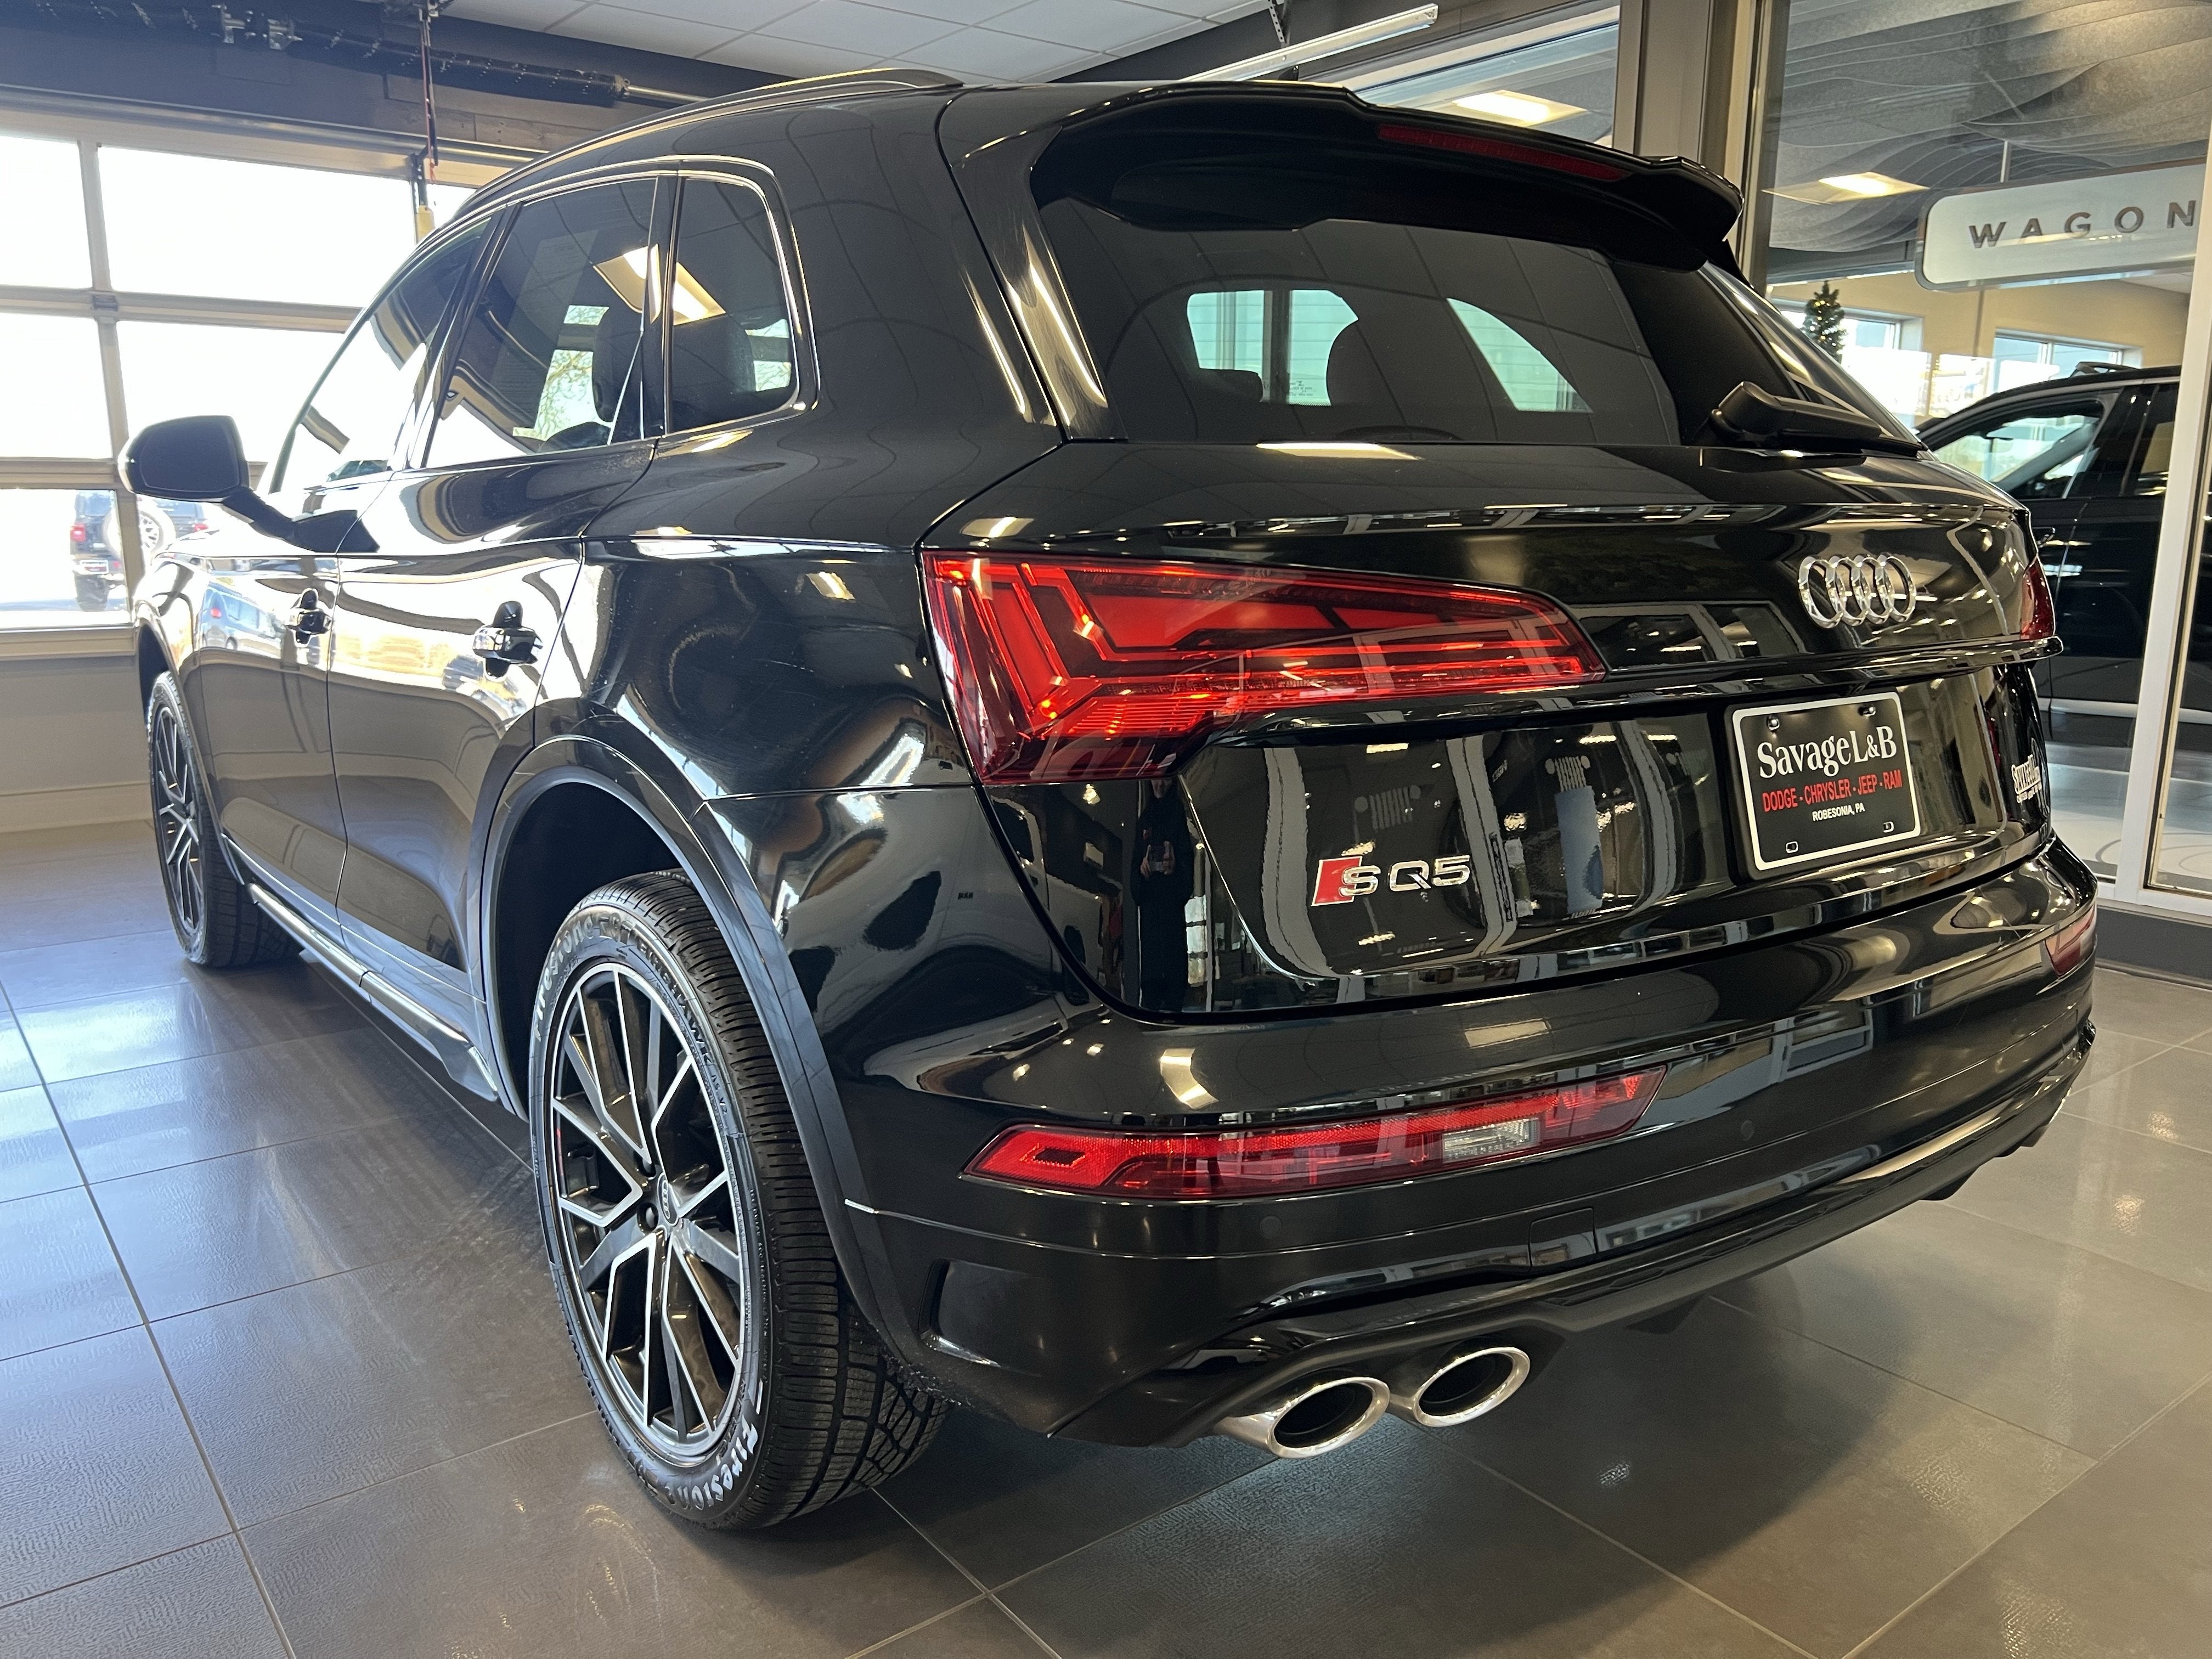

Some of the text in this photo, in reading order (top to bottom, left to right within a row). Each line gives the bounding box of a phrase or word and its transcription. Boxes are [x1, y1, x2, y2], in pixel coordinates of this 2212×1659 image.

[1968, 200, 2197, 249] WAGON
[1762, 770, 1903, 812] DODGE CHRYSLER JEEP RAM
[1855, 802, 1865, 813] PA
[1339, 855, 1470, 896] SQ5
